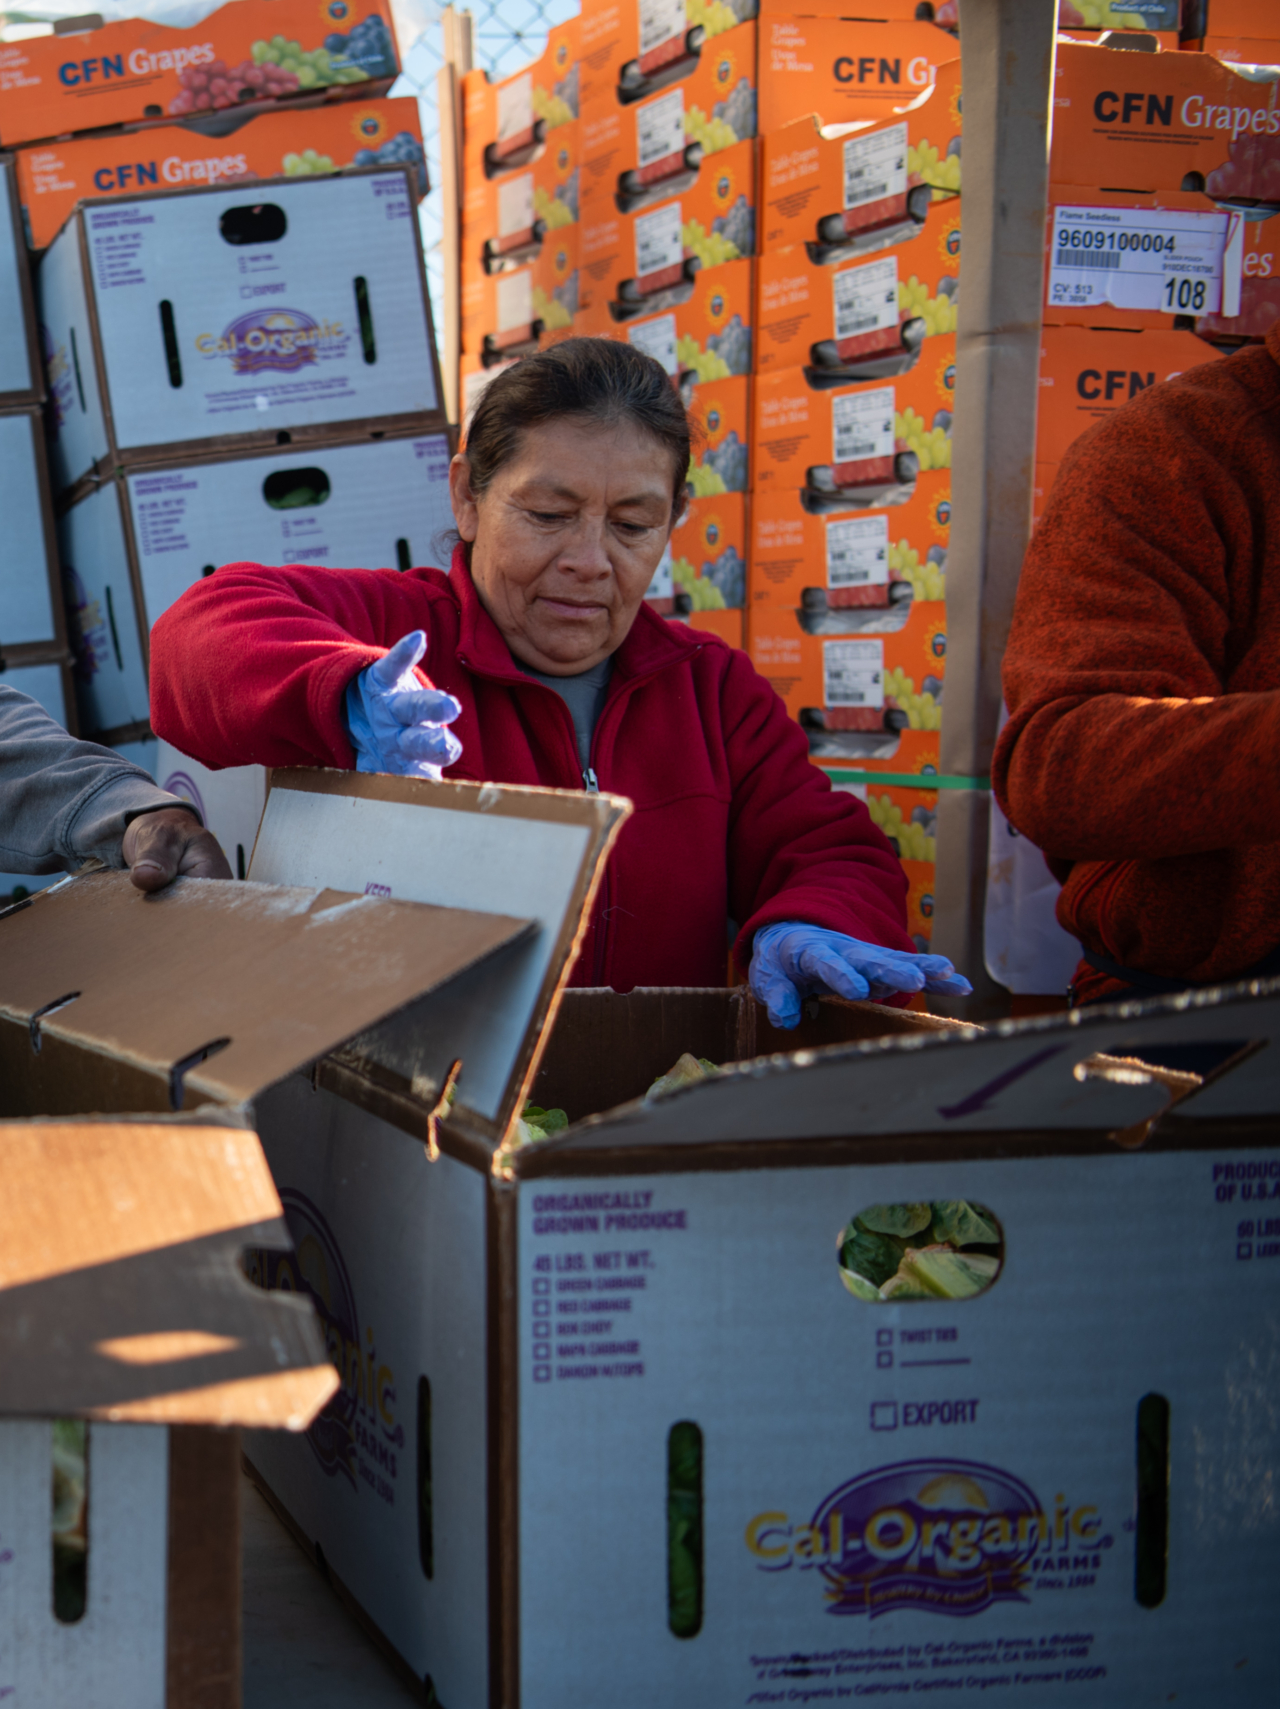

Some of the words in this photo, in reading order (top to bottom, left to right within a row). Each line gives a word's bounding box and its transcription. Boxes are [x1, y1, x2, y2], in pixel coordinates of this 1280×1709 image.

[58, 54, 125, 87] CFN
[128, 43, 215, 79] Grapes
[833, 57, 901, 84] CFN
[1093, 91, 1173, 126] CFN
[1180, 94, 1280, 144] Grapes
[93, 162, 159, 192] CFN
[162, 154, 248, 184] Grapes
[1059, 210, 1083, 220] Flame
[1085, 212, 1121, 222] Seedless
[1058, 229, 1176, 253] 9609100004
[1075, 284, 1093, 294] 513
[1165, 277, 1206, 310] 108
[195, 318, 344, 357] Cal-Organic
[1076, 369, 1156, 400] CFN
[533, 1191, 653, 1213] ORGANICALLY
[1215, 1183, 1237, 1203] OF
[533, 1214, 599, 1235] GROWN
[605, 1209, 686, 1232] PRODUCE
[556, 1253, 586, 1271] LBS.
[593, 1252, 620, 1270] NET
[625, 1250, 655, 1269] WT.
[903, 1398, 980, 1426] EXPORT
[355, 1419, 397, 1479] FARMS
[745, 1493, 1102, 1572] Cal-Organic
[1032, 1554, 1101, 1573] FARMS
[1035, 1576, 1065, 1590] Since
